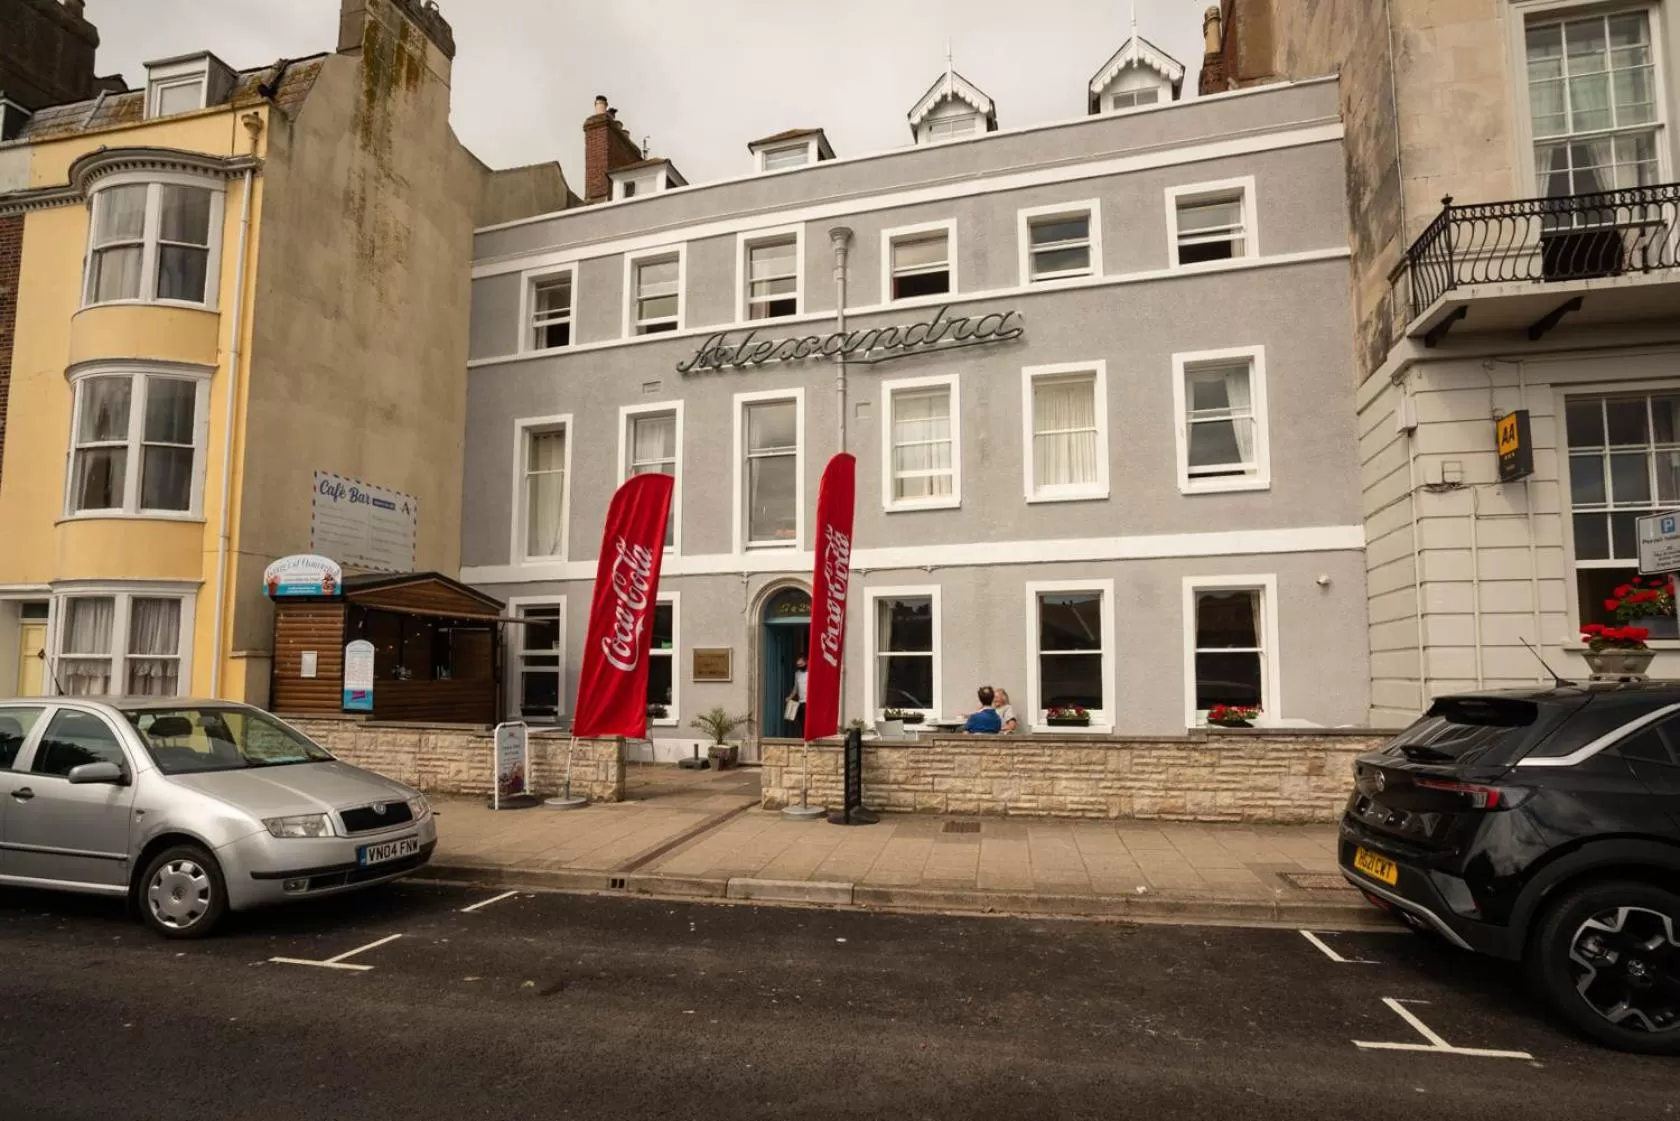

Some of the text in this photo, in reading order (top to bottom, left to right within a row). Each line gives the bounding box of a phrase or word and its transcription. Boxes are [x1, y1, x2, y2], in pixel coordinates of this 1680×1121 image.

[676, 304, 1024, 373] Alexandra
[1501, 423, 1516, 447] AA
[320, 479, 346, 502] Café
[348, 486, 371, 505] Bar
[601, 535, 653, 672] Coca-Cola
[368, 839, 418, 861] VN04 FNW
